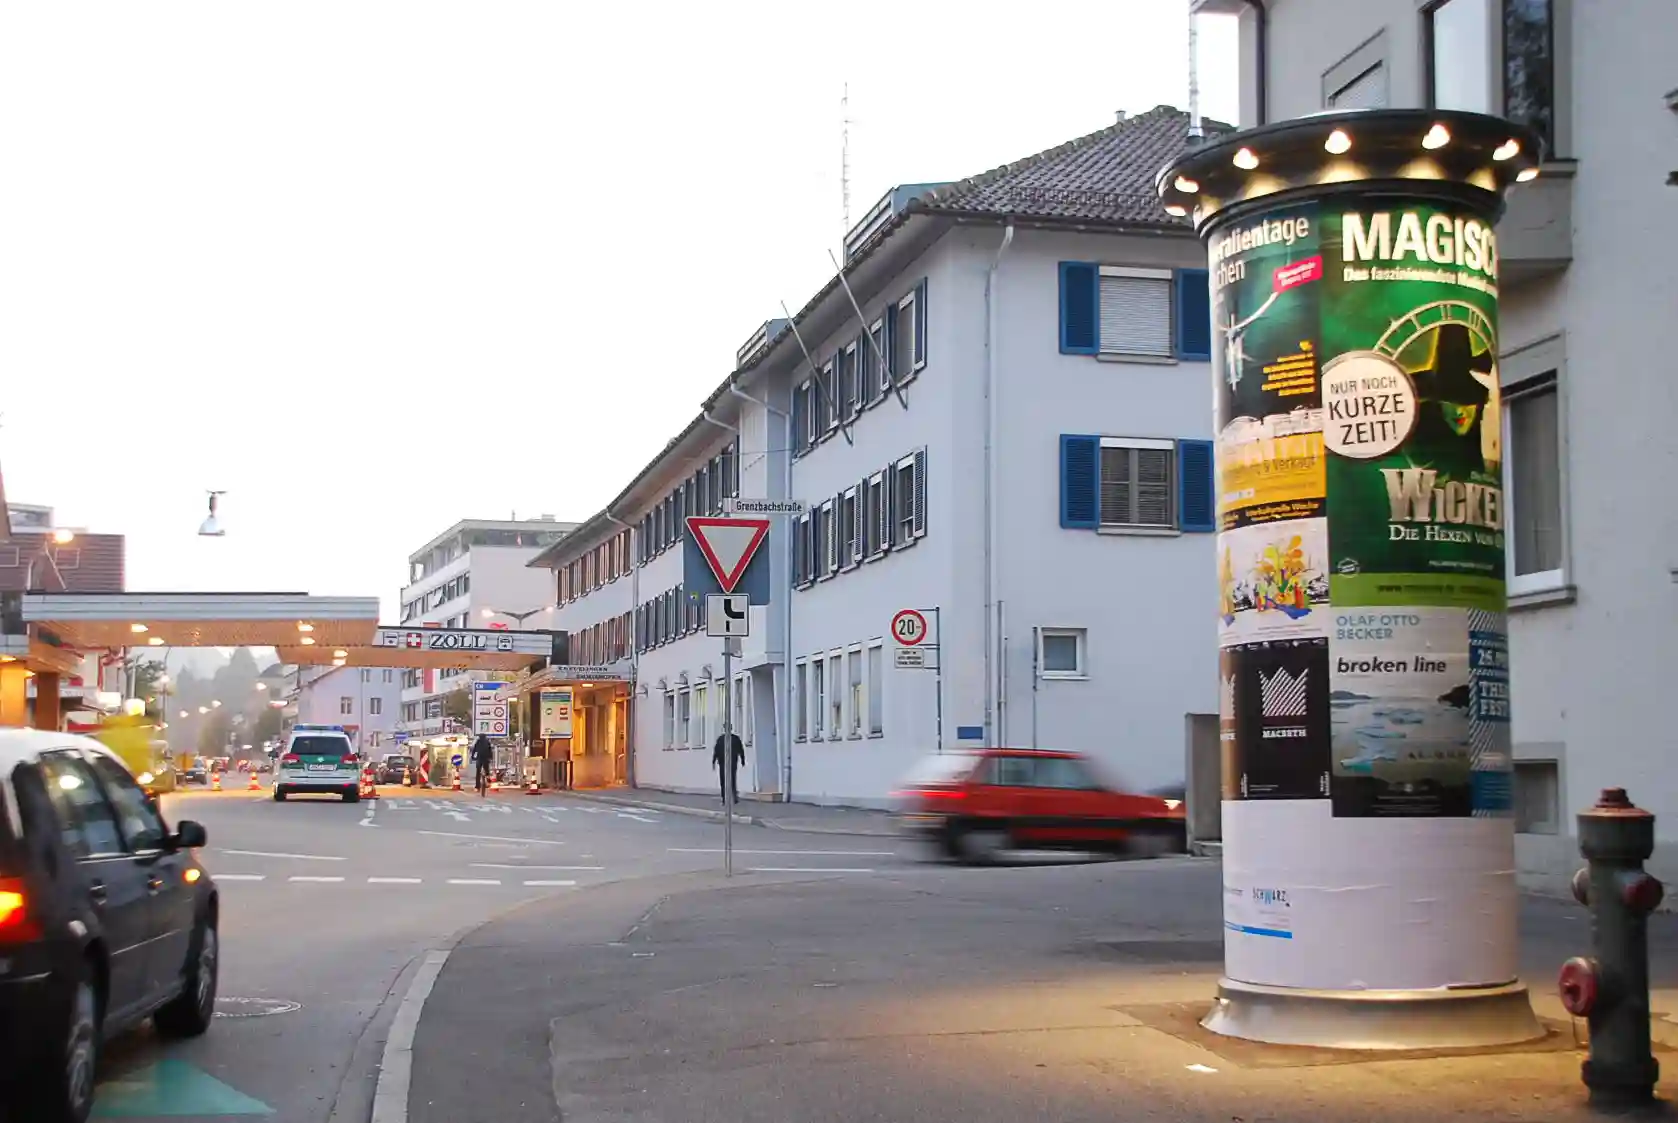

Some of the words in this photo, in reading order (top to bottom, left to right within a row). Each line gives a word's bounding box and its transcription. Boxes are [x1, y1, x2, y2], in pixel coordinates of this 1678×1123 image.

[1330, 380, 1358, 395] NUR
[1361, 376, 1398, 390] NOCH
[1328, 393, 1405, 420] KURZE
[1340, 420, 1398, 446] ZEIT!
[736, 501, 803, 512] Grenzbachstraße
[1388, 524, 1420, 541] DIE
[1424, 525, 1471, 542] HEXEN
[898, 619, 915, 636] 20
[1336, 615, 1377, 627] OLAF
[1379, 614, 1421, 627] OTTO
[430, 633, 487, 650] ZOLL
[1336, 628, 1394, 640] BECKER
[1336, 657, 1408, 673] broken
[1413, 655, 1447, 673] line
[1262, 729, 1307, 739] MACBETH
